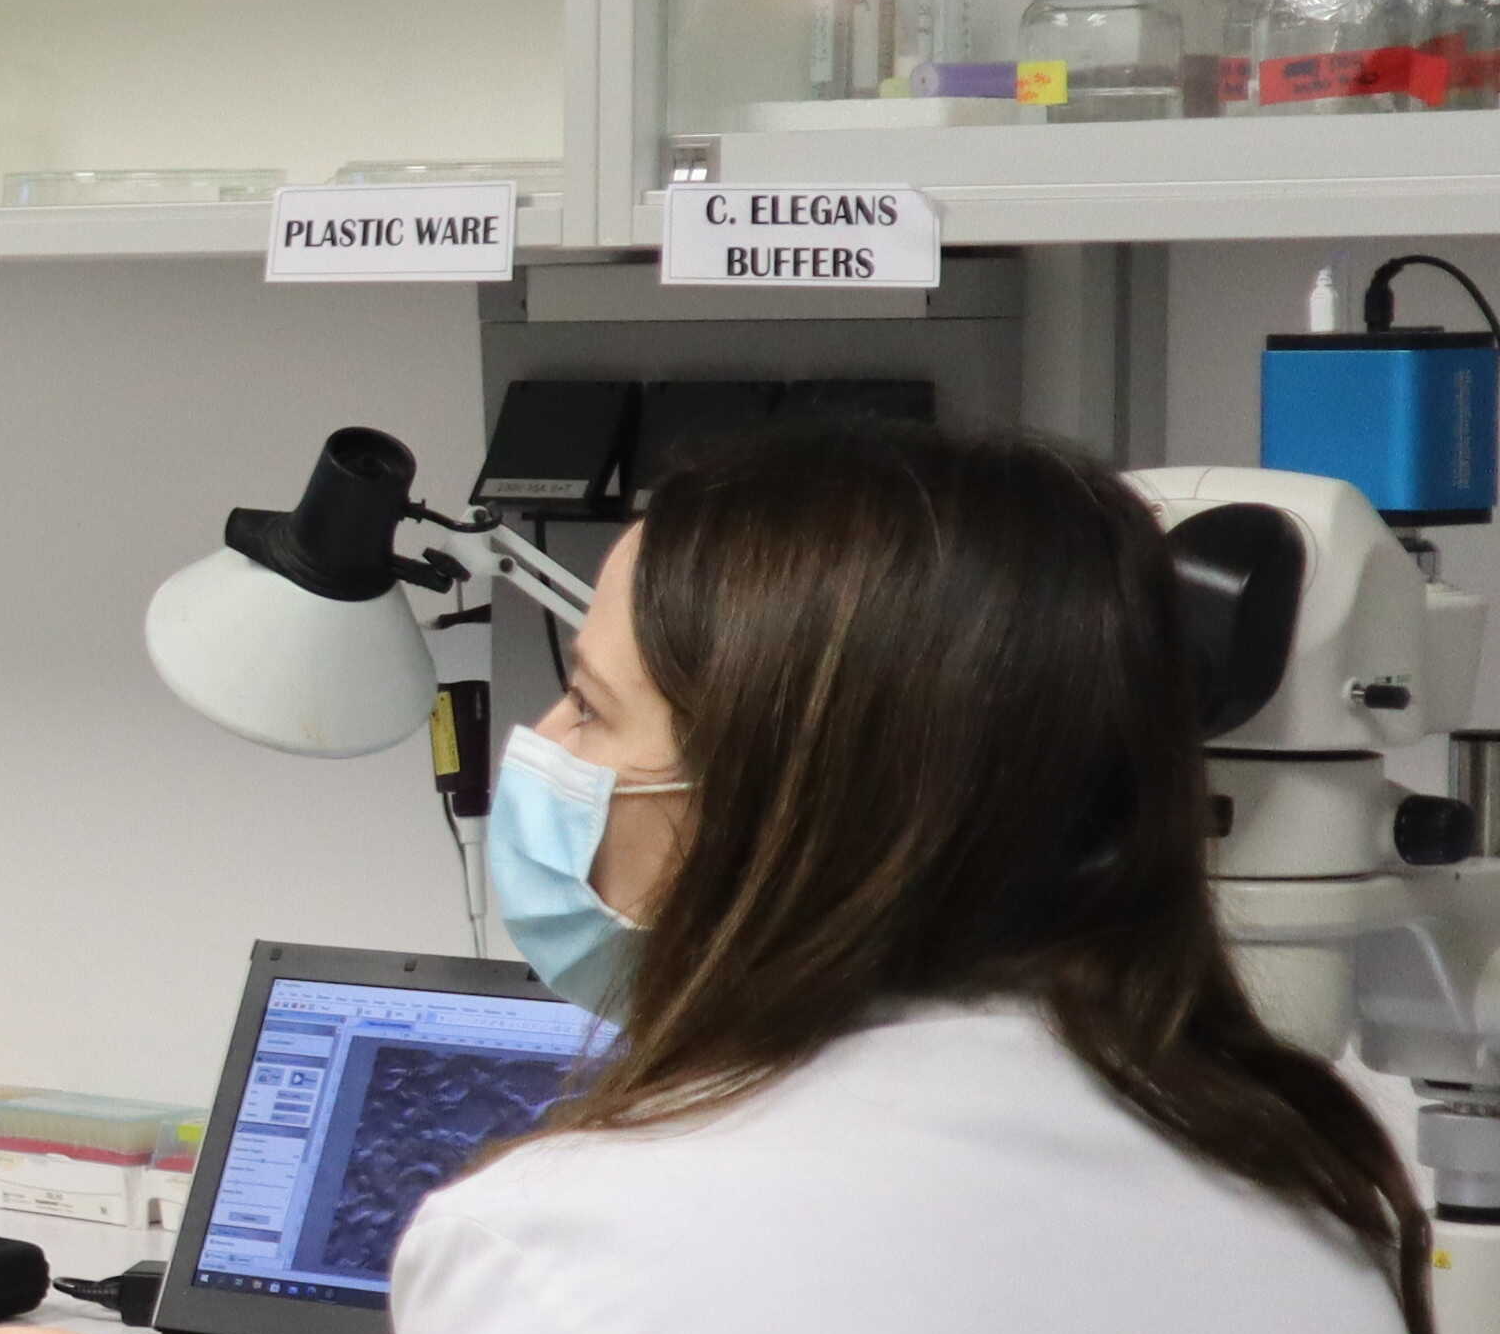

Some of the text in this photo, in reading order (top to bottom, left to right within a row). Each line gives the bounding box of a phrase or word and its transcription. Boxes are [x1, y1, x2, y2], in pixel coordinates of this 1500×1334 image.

[705, 194, 899, 227] C. ELEGANS
[283, 215, 501, 248] PLASTIC WARE
[726, 246, 876, 279] BUFFERS
